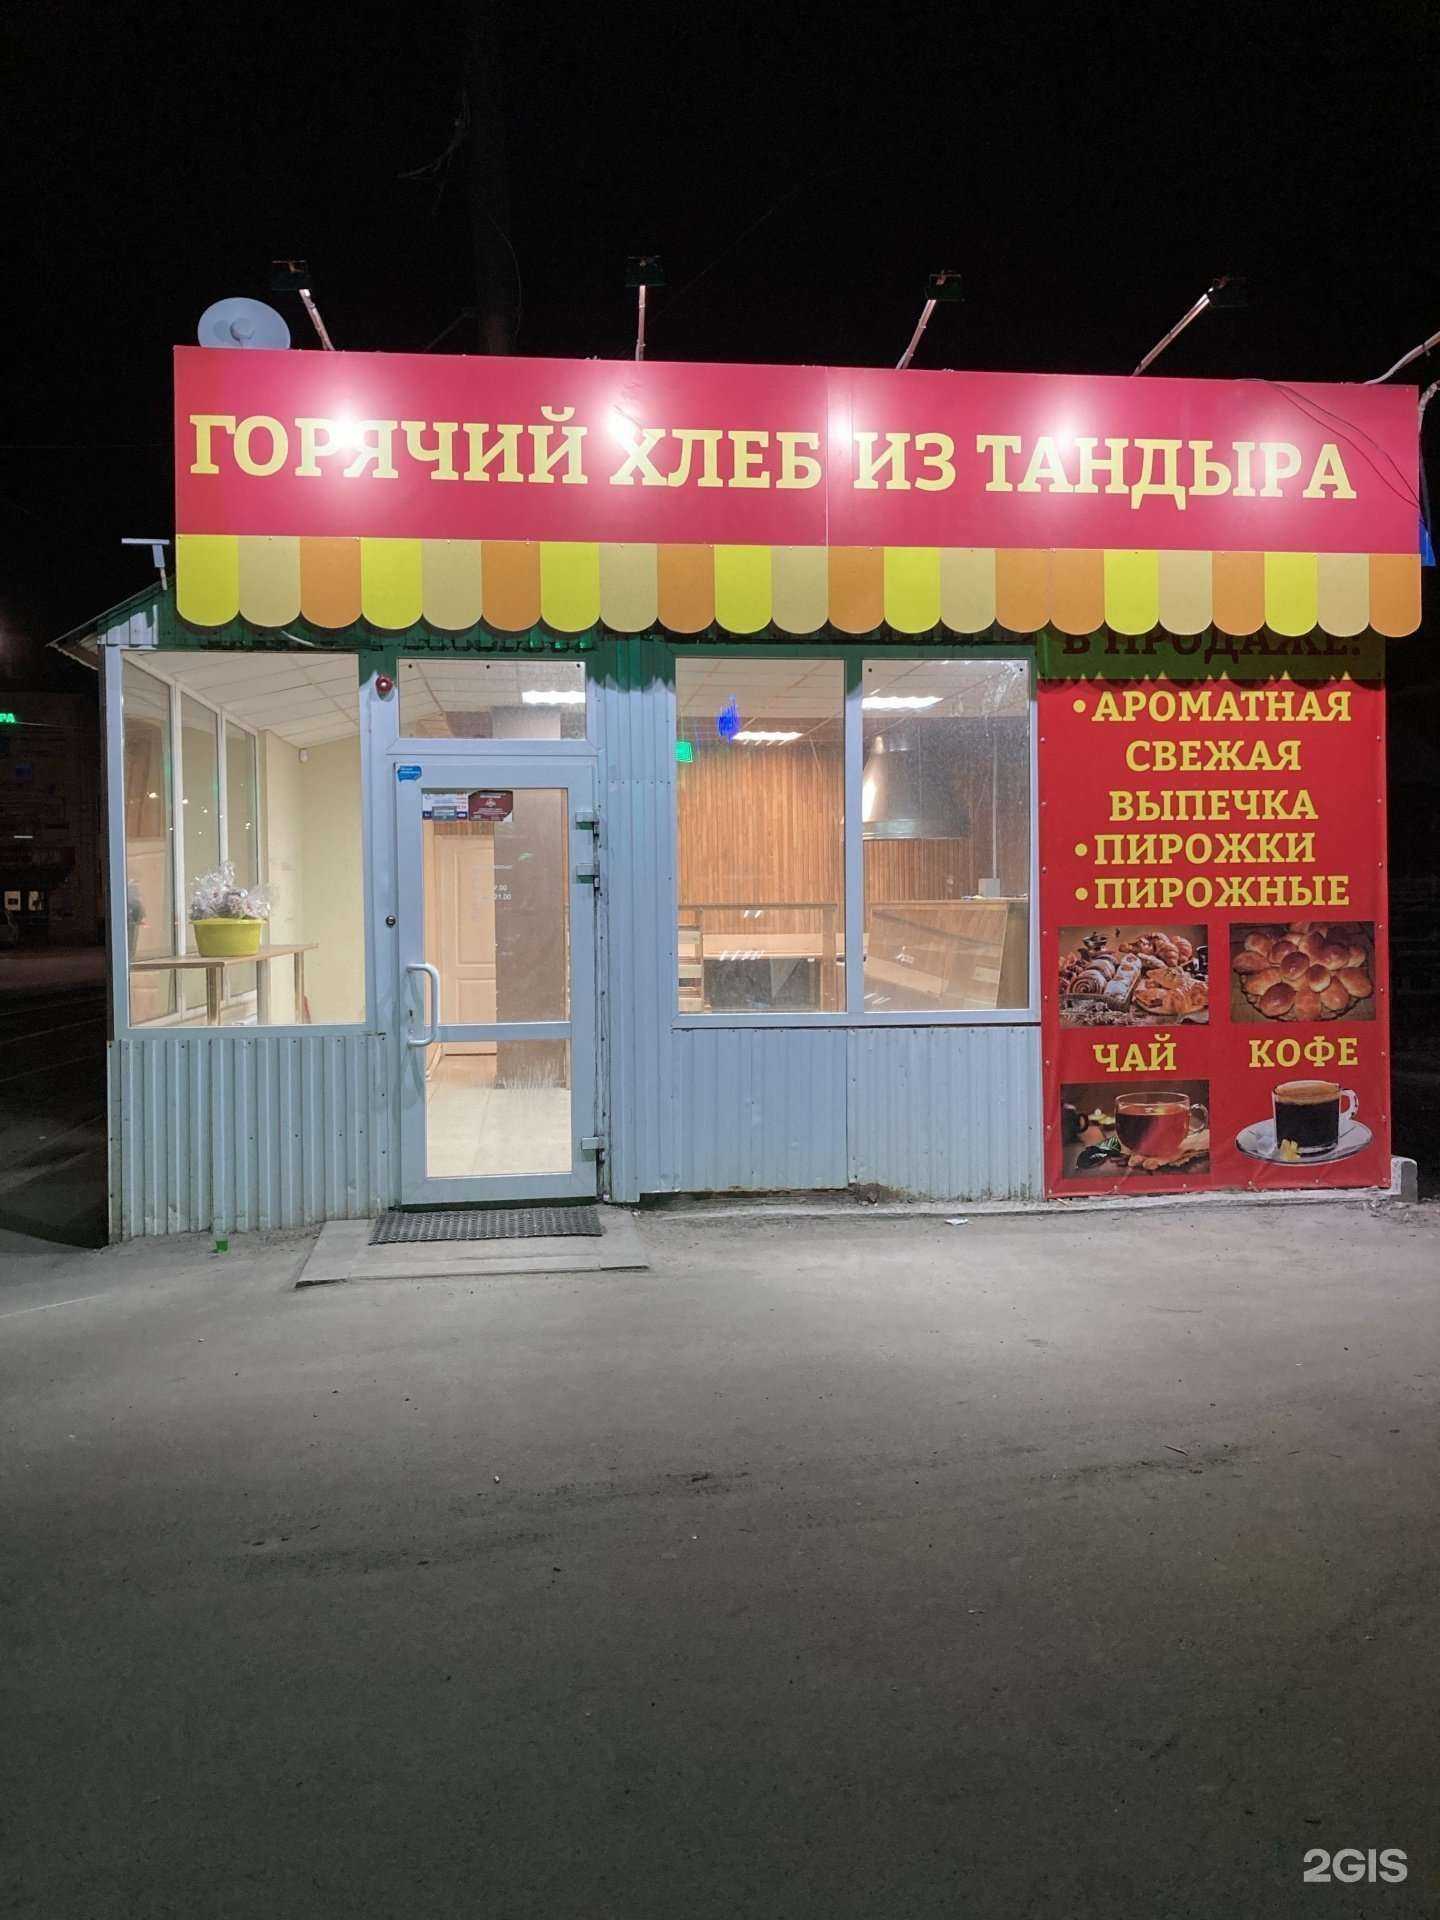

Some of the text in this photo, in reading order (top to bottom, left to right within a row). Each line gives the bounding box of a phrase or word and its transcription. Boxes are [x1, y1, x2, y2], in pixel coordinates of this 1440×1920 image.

[189, 406, 1357, 510] ГОРЯЧИЙ ХЛЕБ ИЗ ТАНДЫРА
[1091, 690, 1351, 722] АРОМАТНАЯ
[1125, 740, 1302, 772] СВЕЖАЯ
[1109, 789, 1319, 821] ВЫПЕЧКА
[1094, 832, 1316, 865] ПИРОЖКИ
[1094, 875, 1350, 909] ПИРОЖНЫЕ
[1092, 1033, 1177, 1072] ЧАЙ
[1249, 1035, 1359, 1068] КОФЕ
